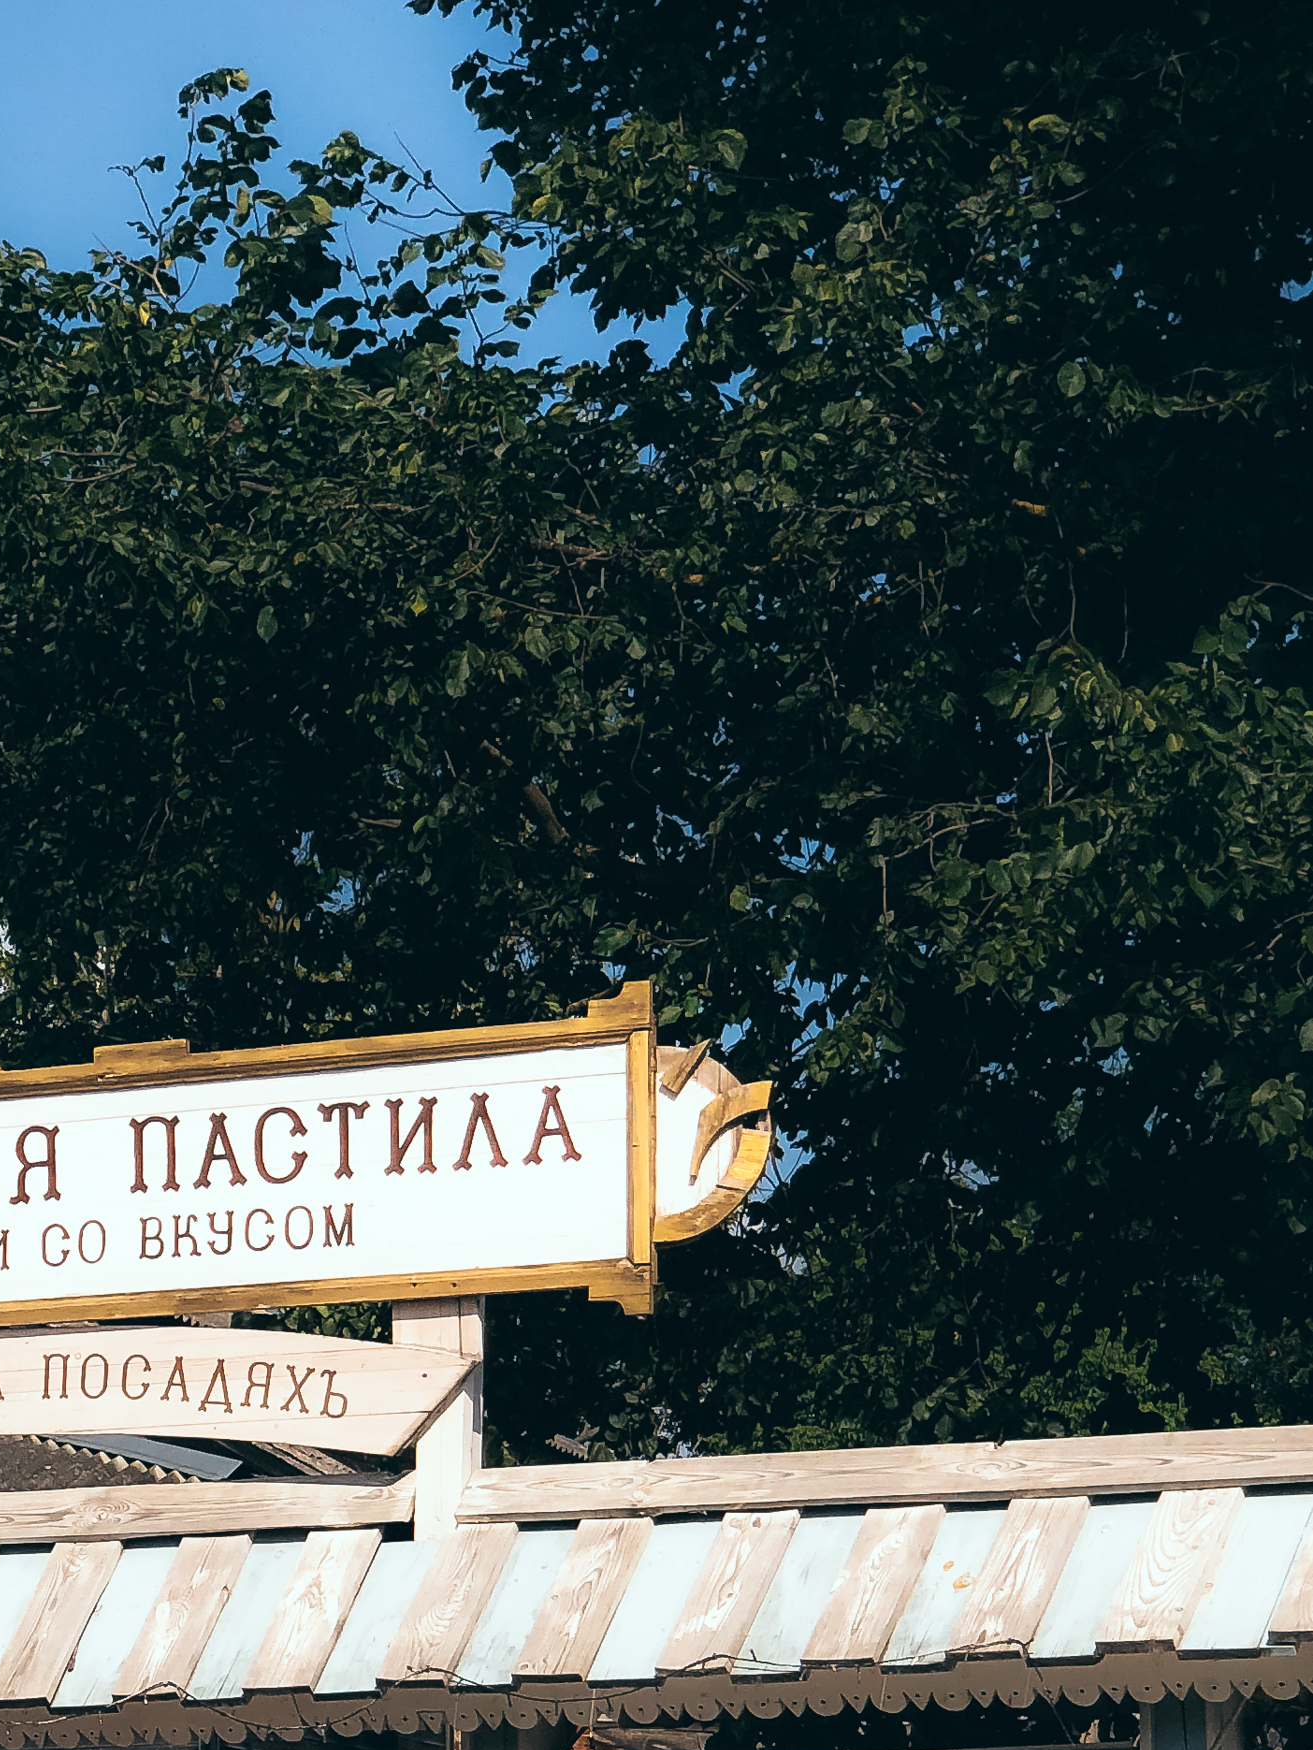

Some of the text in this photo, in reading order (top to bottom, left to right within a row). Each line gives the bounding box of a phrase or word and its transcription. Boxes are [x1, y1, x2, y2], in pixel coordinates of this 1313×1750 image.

[129, 1085, 582, 1193] ПАСТИЛА
[42, 1220, 105, 1267] СО
[139, 1203, 354, 1259] ВКУСОМ
[41, 1353, 348, 1418] ПОСАДЯХЪ
